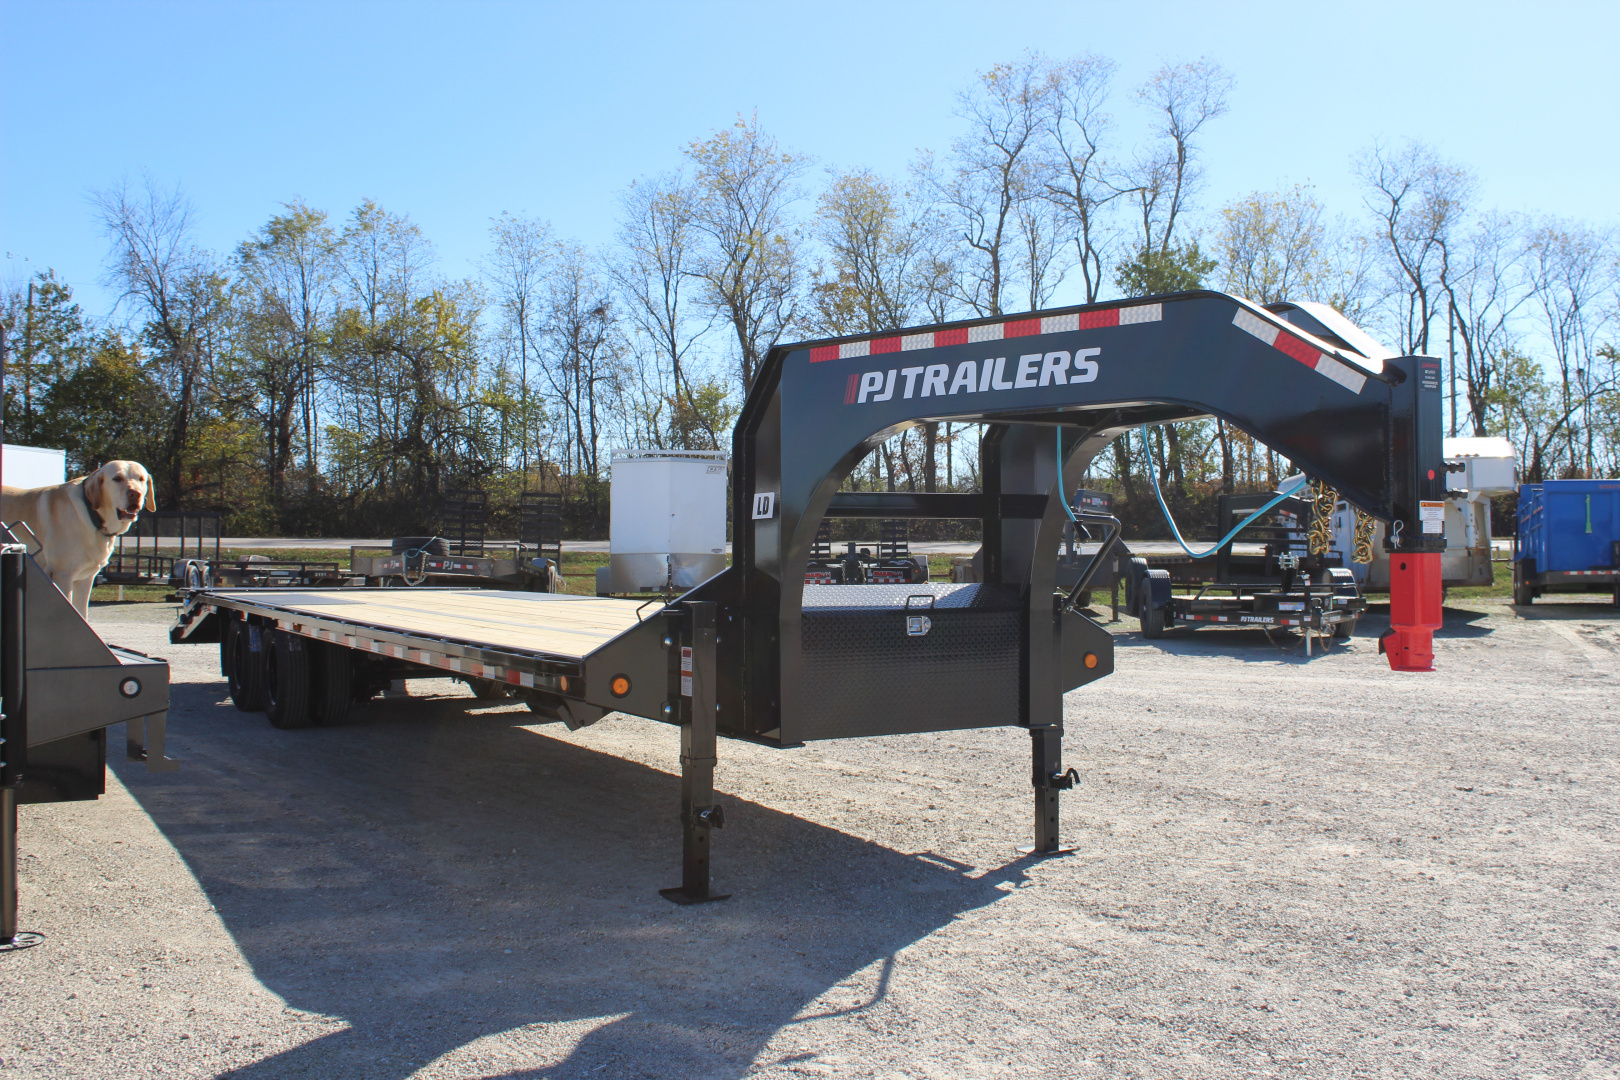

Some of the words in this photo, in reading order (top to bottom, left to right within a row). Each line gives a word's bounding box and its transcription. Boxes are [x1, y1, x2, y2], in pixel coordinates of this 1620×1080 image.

[857, 369, 897, 404] PJ
[901, 347, 1101, 399] TRAILERS
[757, 496, 770, 516] LD
[442, 560, 454, 570] PJ
